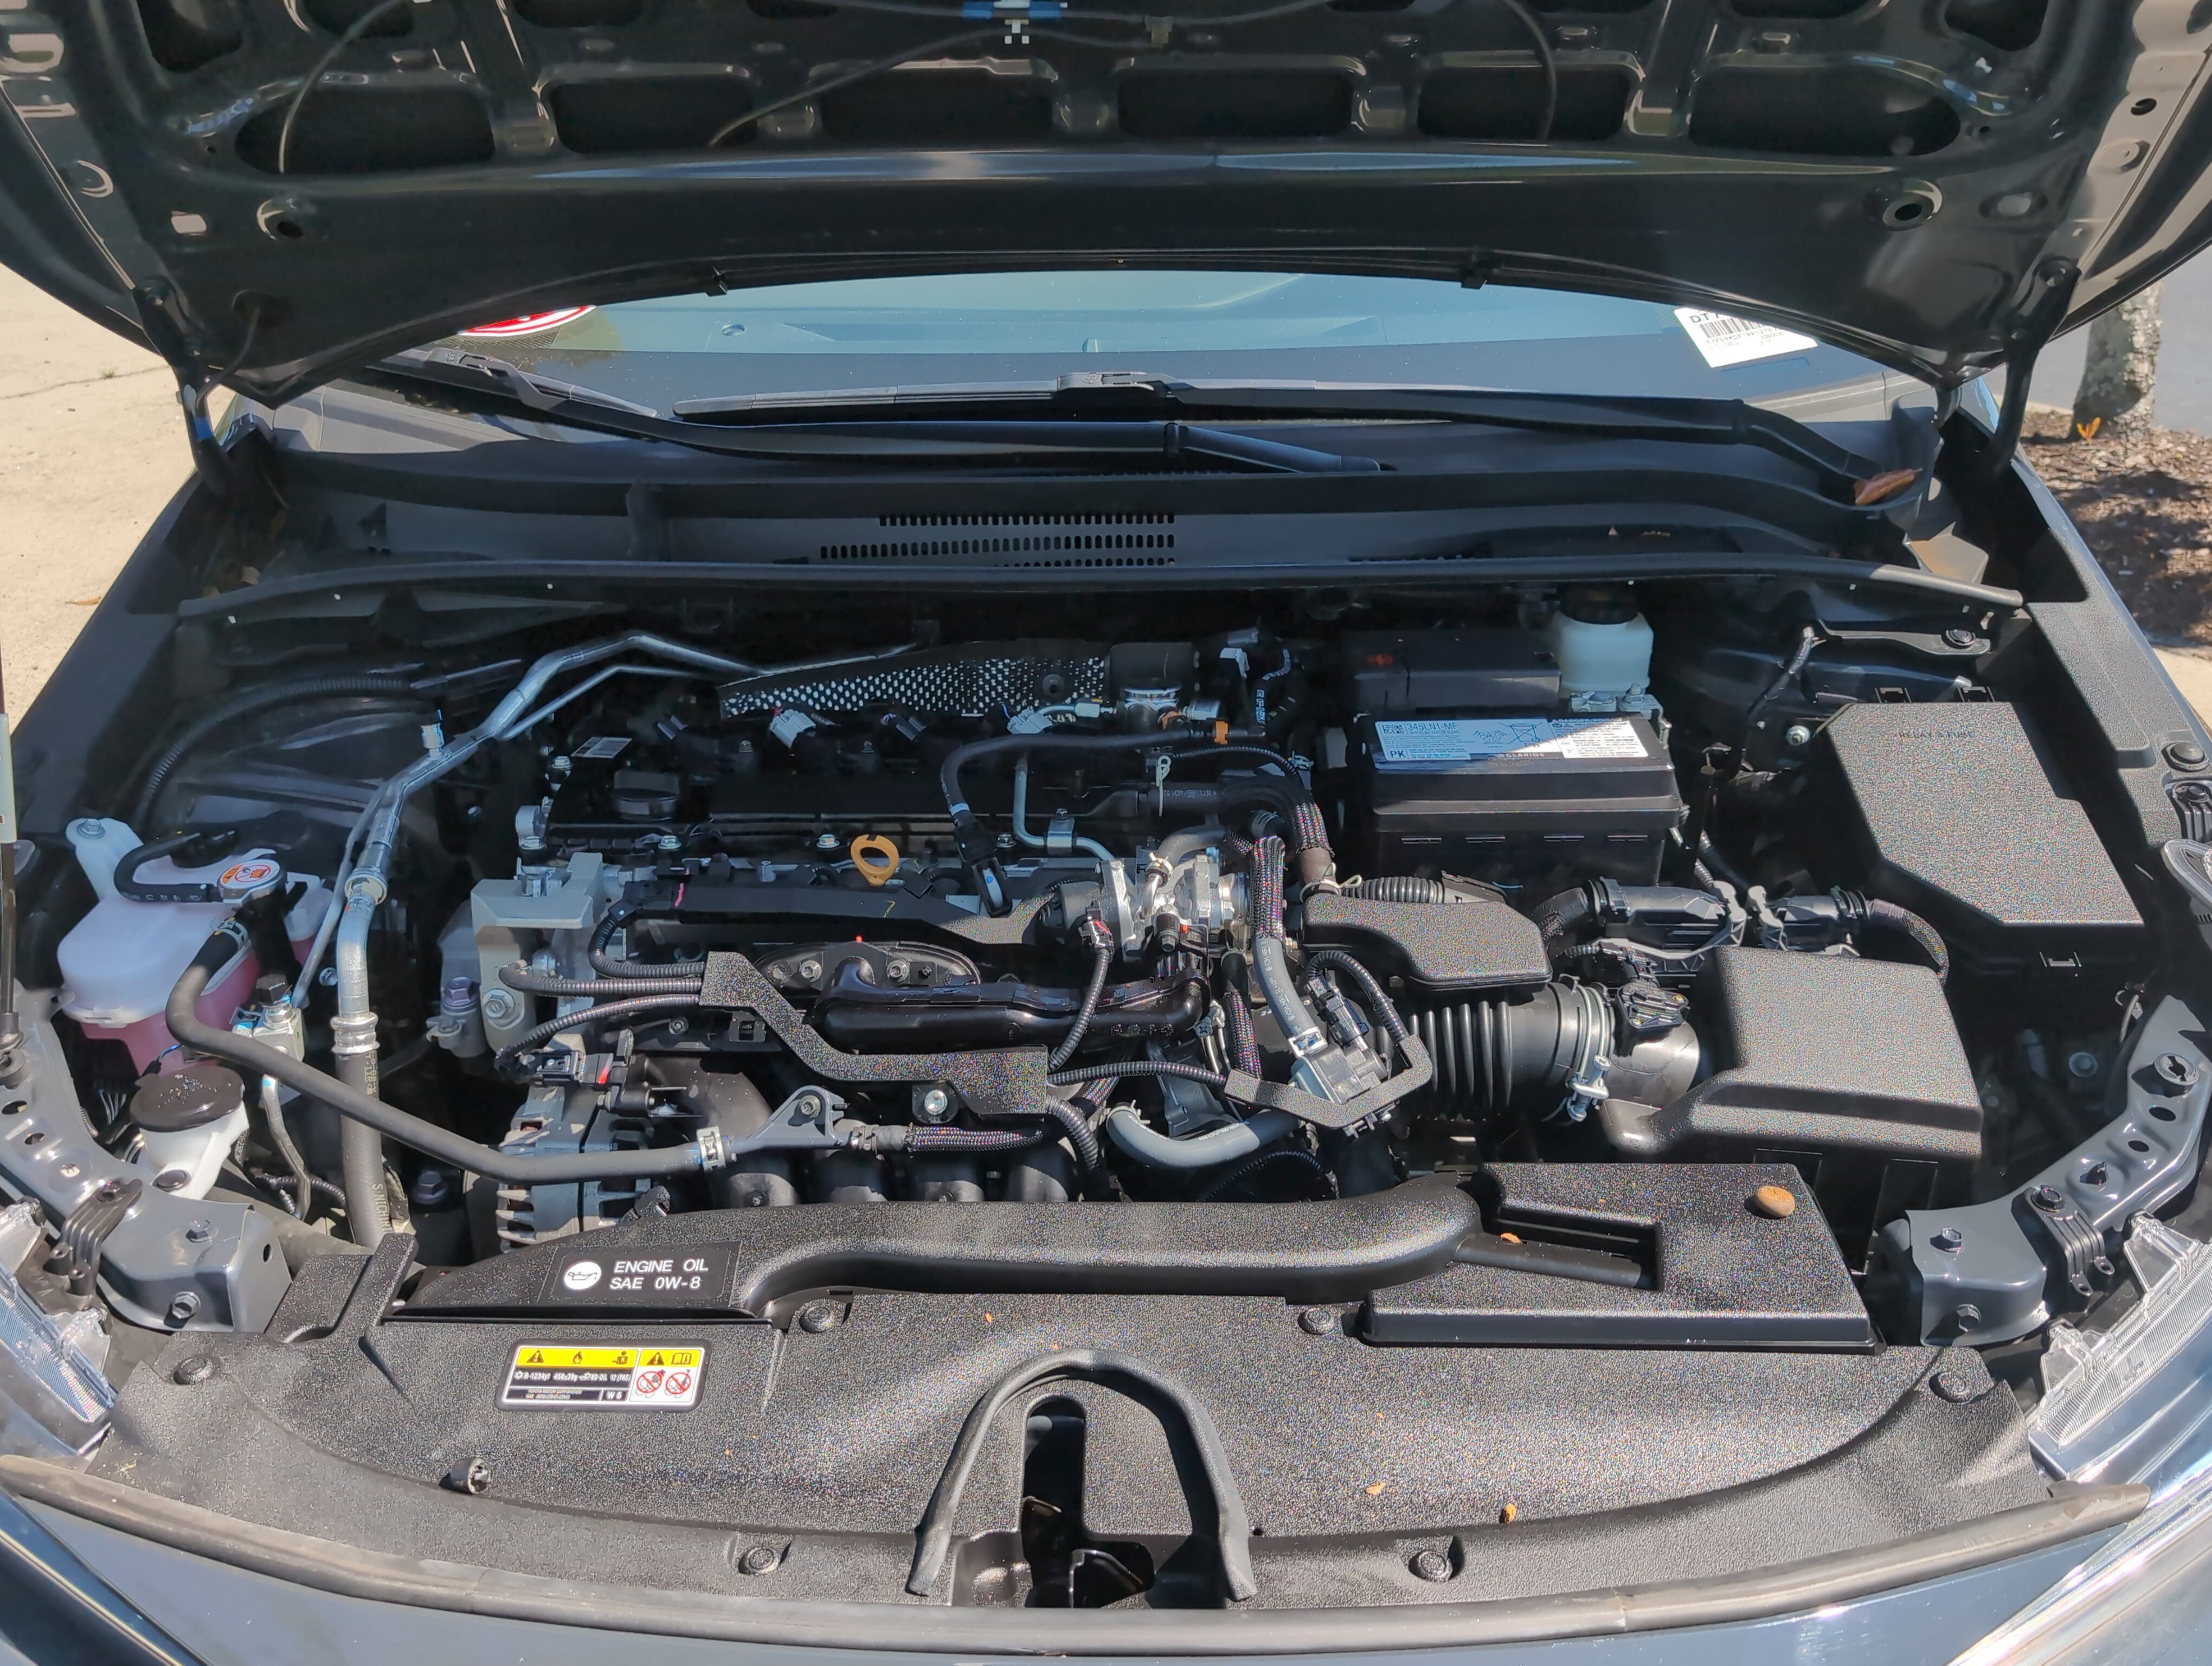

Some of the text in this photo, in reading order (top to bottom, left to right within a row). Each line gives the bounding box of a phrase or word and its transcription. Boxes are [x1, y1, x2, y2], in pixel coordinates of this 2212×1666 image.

[1390, 750, 1405, 758] PK
[614, 1259, 709, 1273] ENGINE OIL
[609, 1276, 701, 1290] SAE 0W-8
[606, 1391, 622, 1400] W 6
